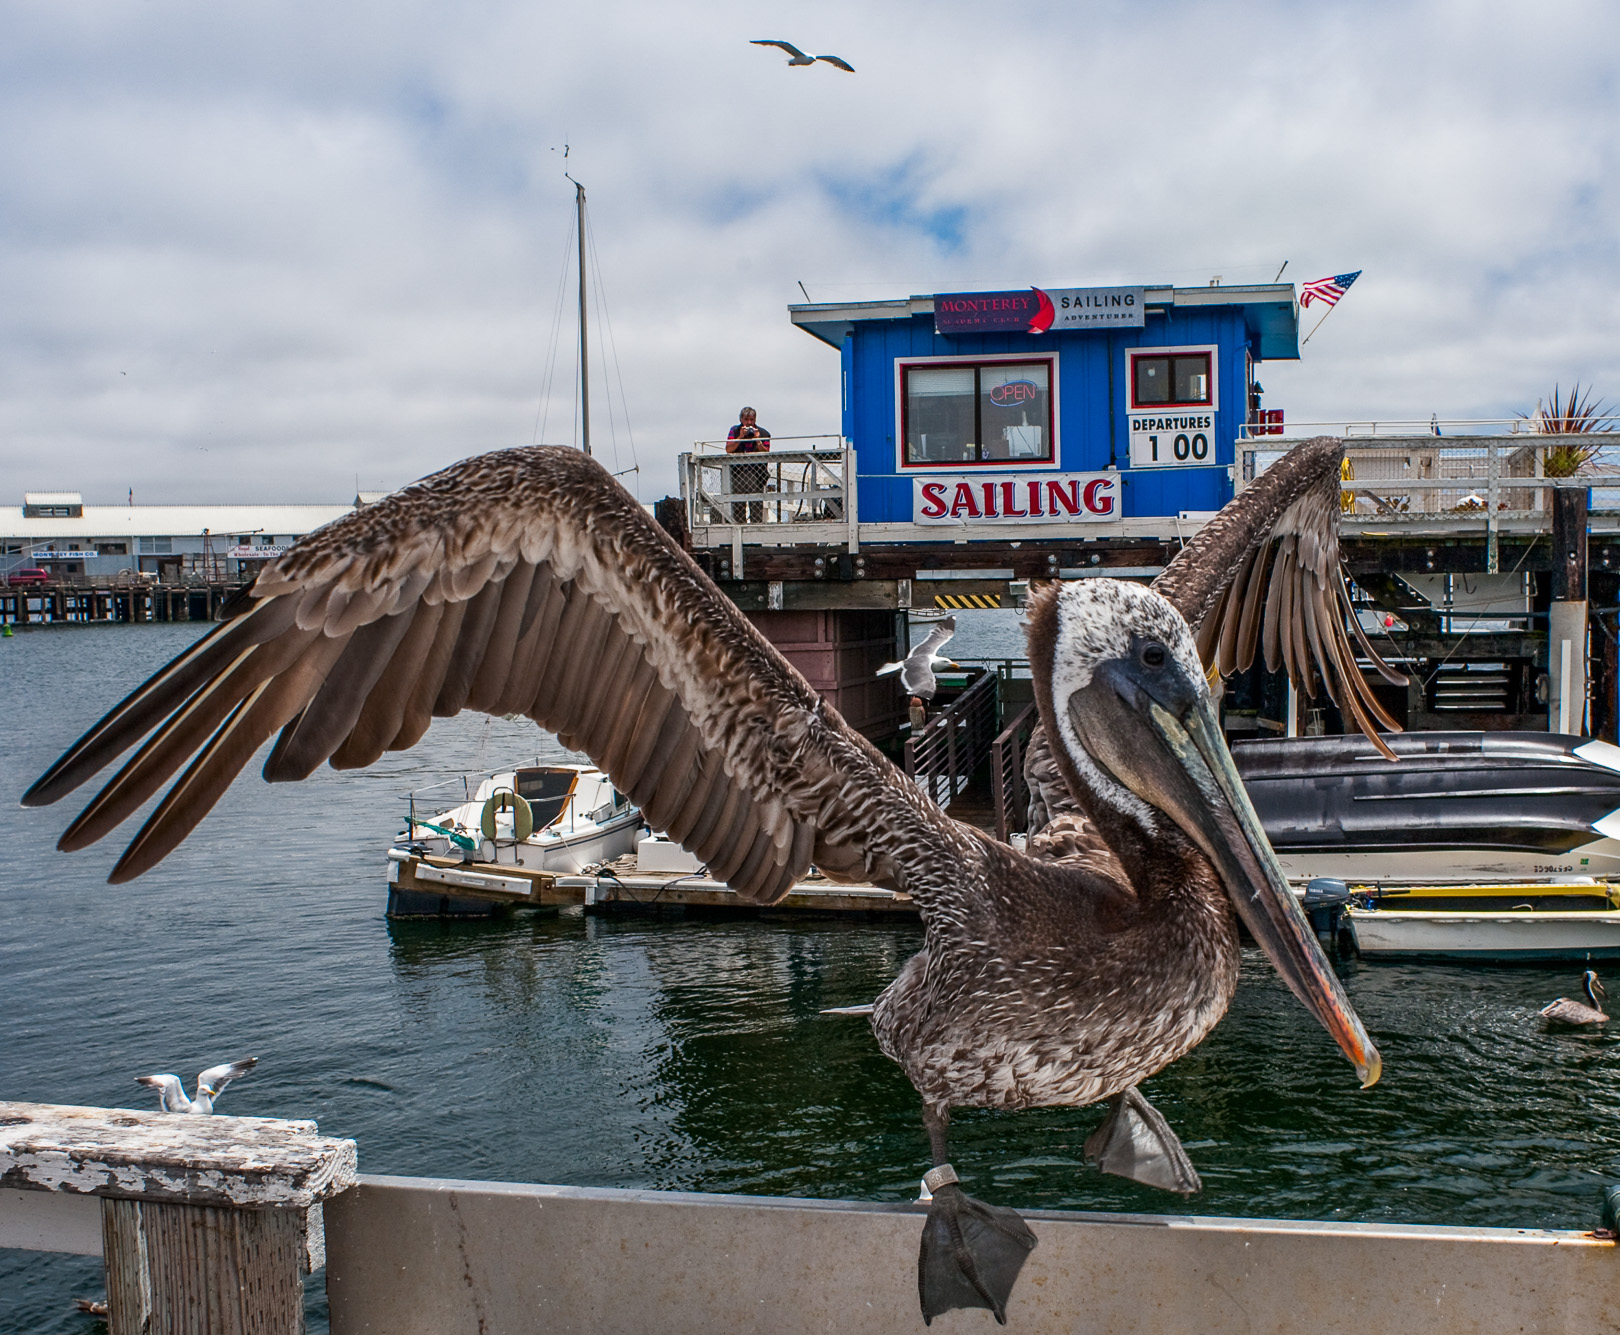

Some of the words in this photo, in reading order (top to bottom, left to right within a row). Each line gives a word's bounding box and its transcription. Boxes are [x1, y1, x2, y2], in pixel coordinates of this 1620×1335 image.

[941, 298, 1030, 312] MONTEREY
[1061, 294, 1135, 309] SAILING
[1064, 313, 1134, 321] ADVENTURES
[990, 385, 1036, 400] OPEN
[1132, 416, 1211, 432] DEPARTURES
[1148, 435, 1159, 462] 1
[920, 478, 1116, 520] SAILING
